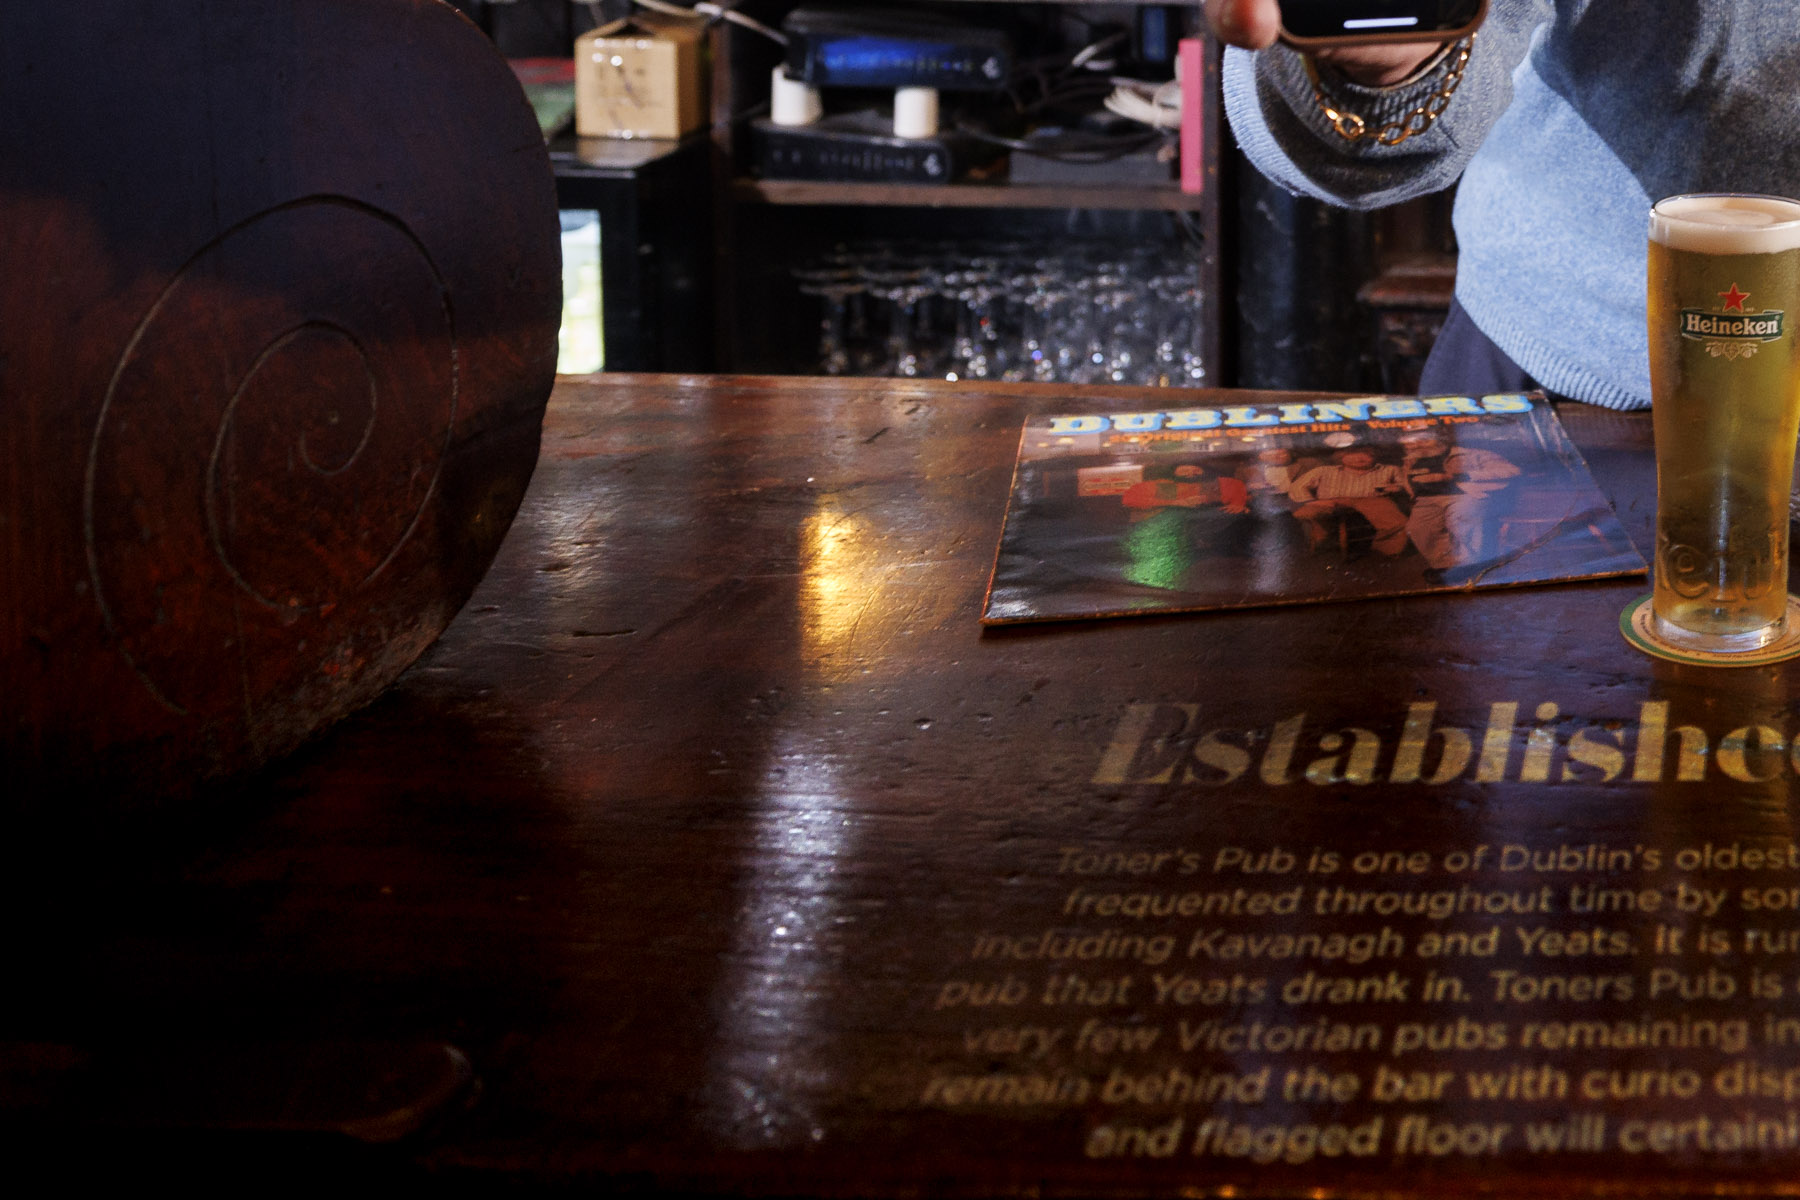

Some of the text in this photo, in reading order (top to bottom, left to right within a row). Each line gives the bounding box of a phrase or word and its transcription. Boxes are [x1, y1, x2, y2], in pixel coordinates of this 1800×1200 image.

[1686, 313, 1779, 336] Heineken
[1048, 394, 1534, 436] DUBLINERS
[1225, 424, 1306, 438] Greatest
[1311, 422, 1351, 434] Hits
[1366, 414, 1480, 431] Volume Two
[1057, 847, 1199, 876] Toner's
[1213, 847, 1296, 875] Pub
[1308, 847, 1339, 873] is
[1352, 853, 1430, 873] one
[1444, 845, 1488, 872] of
[1501, 845, 1660, 872] Dublin's
[1676, 843, 1800, 870] oldest
[1064, 887, 1302, 918] frequented
[1315, 887, 1553, 919] throughout
[1570, 885, 1659, 912] time
[1677, 884, 1726, 915] by
[971, 929, 1177, 965] including
[1188, 927, 1403, 964] Kavanagh
[1416, 926, 1498, 958] and
[1517, 926, 1638, 956] Yeats.
[1655, 925, 1683, 954] It
[1700, 925, 1730, 954] is
[935, 976, 1027, 1009] pub
[1042, 973, 1132, 1003] that
[1153, 973, 1267, 1003] Yeats
[1282, 971, 1409, 1001] drank
[1423, 971, 1472, 1001] in.
[1490, 971, 1634, 1001] Toners
[1649, 968, 1736, 1000] Pub
[1750, 968, 1783, 998] is
[963, 1028, 1064, 1060] very
[1075, 1018, 1159, 1051] few
[1179, 1018, 1381, 1051] Victorian
[1394, 1016, 1507, 1055] pubs
[1523, 1015, 1749, 1051] remaining
[1765, 1013, 1800, 1042] in
[921, 1071, 1091, 1100] remain
[1103, 1067, 1269, 1100] behind
[1284, 1065, 1358, 1098] the
[1373, 1064, 1453, 1099] bar
[1466, 1063, 1567, 1098] with
[1582, 1066, 1699, 1097] curio
[1085, 1117, 1184, 1157] and
[1194, 1117, 1382, 1164] flagged
[1395, 1116, 1512, 1155] floor
[1525, 1112, 1605, 1153] will
